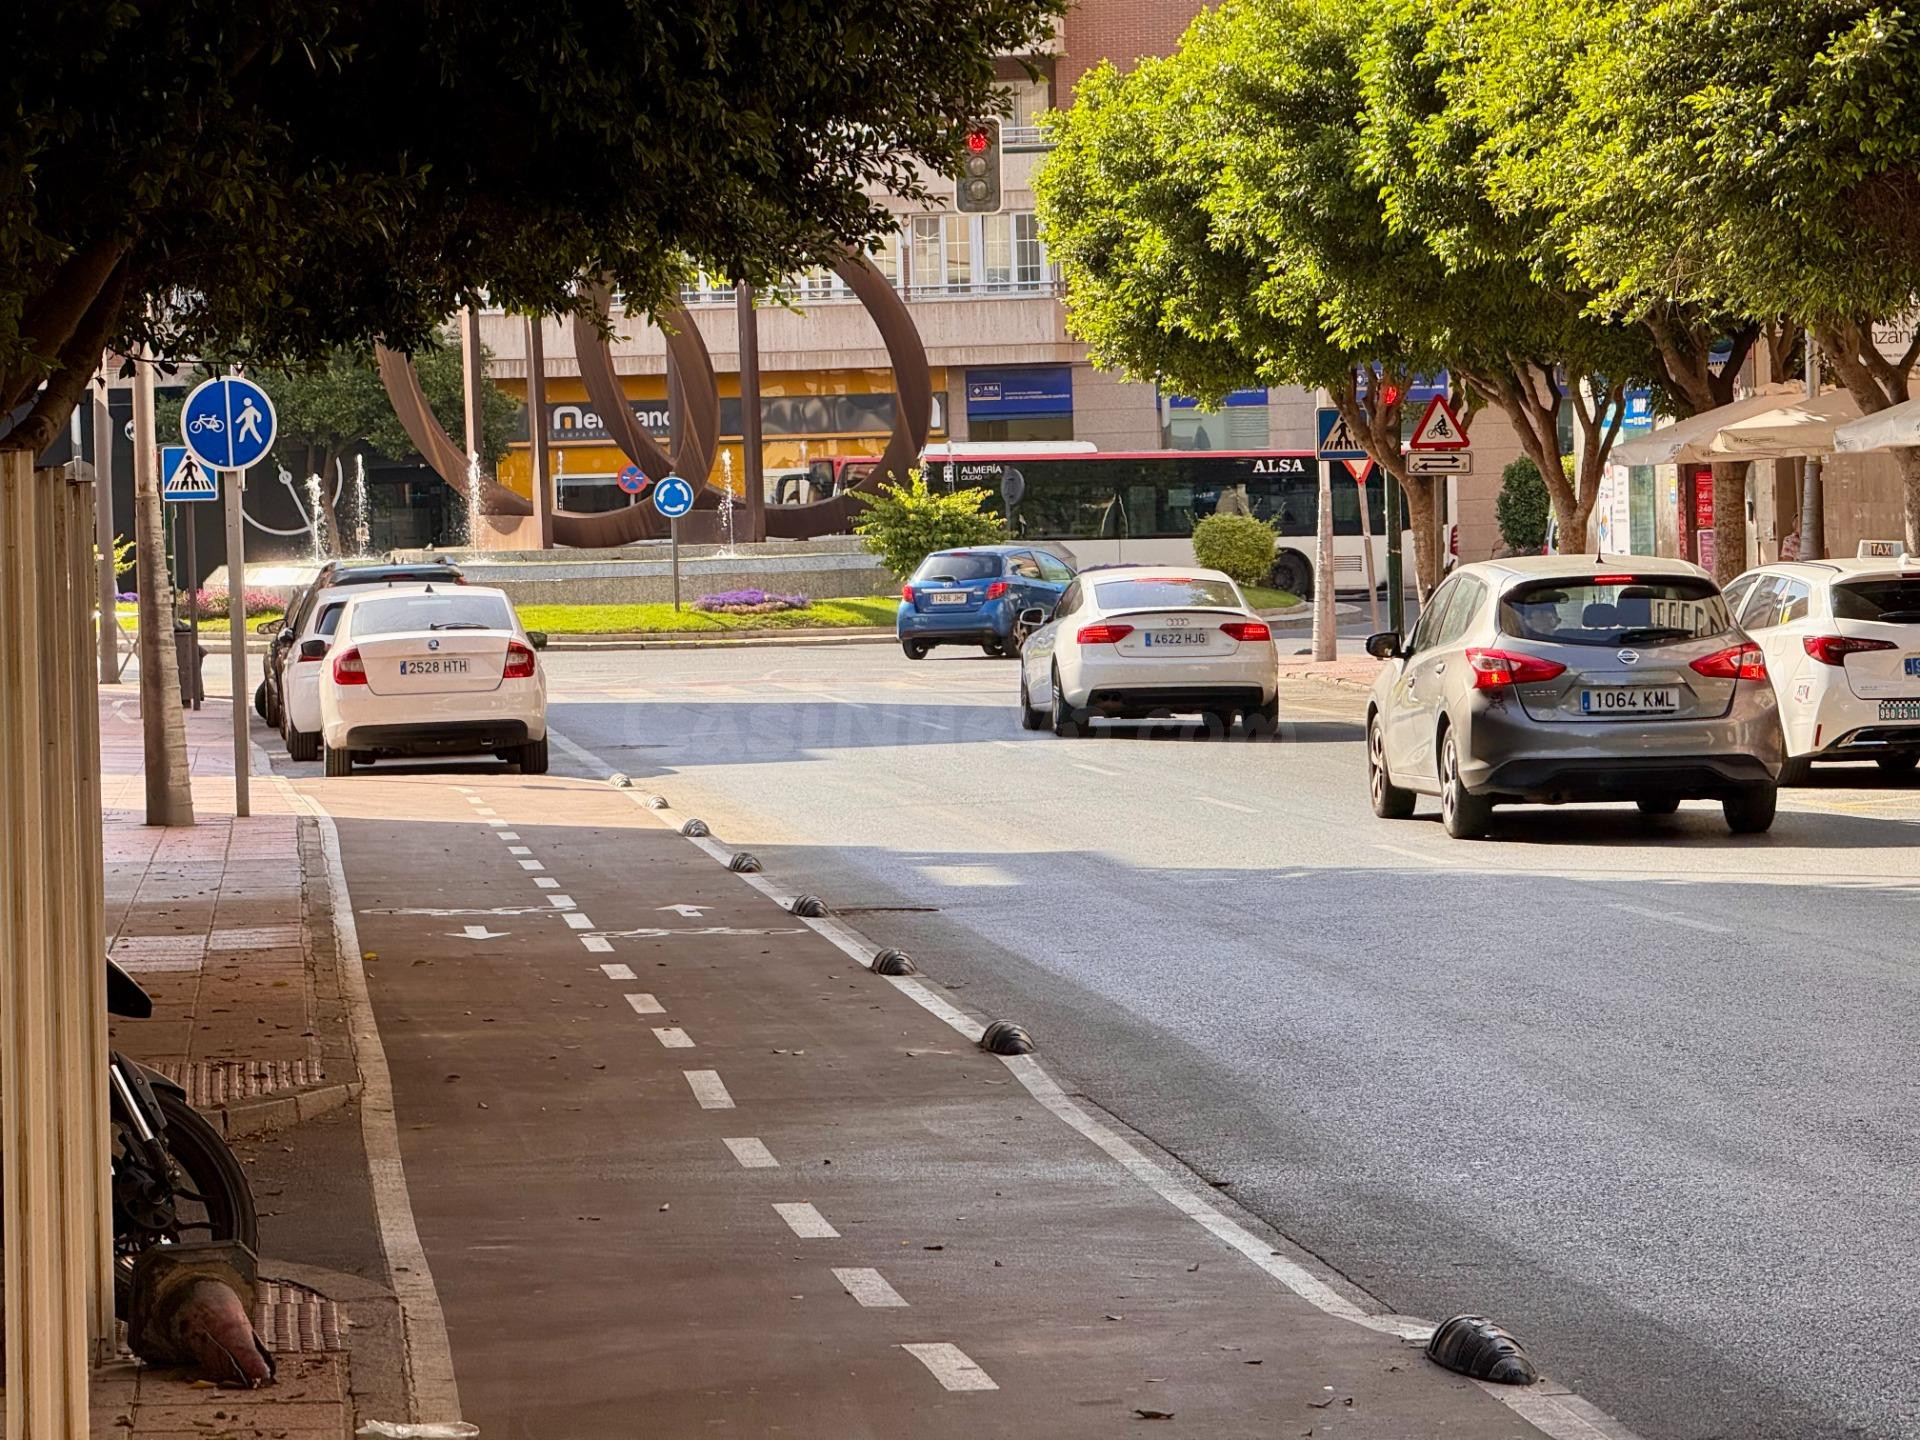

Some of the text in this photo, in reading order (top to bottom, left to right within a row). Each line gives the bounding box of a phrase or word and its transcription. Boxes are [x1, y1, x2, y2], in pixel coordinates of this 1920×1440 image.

[961, 464, 1002, 474] ALMERÍA
[1253, 459, 1305, 473] ALSA
[1872, 543, 1893, 555] TAXI
[1154, 633, 1205, 644] 4622 HJG
[409, 660, 467, 674] 2528 HTH
[1596, 691, 1675, 708] 1064 KML
